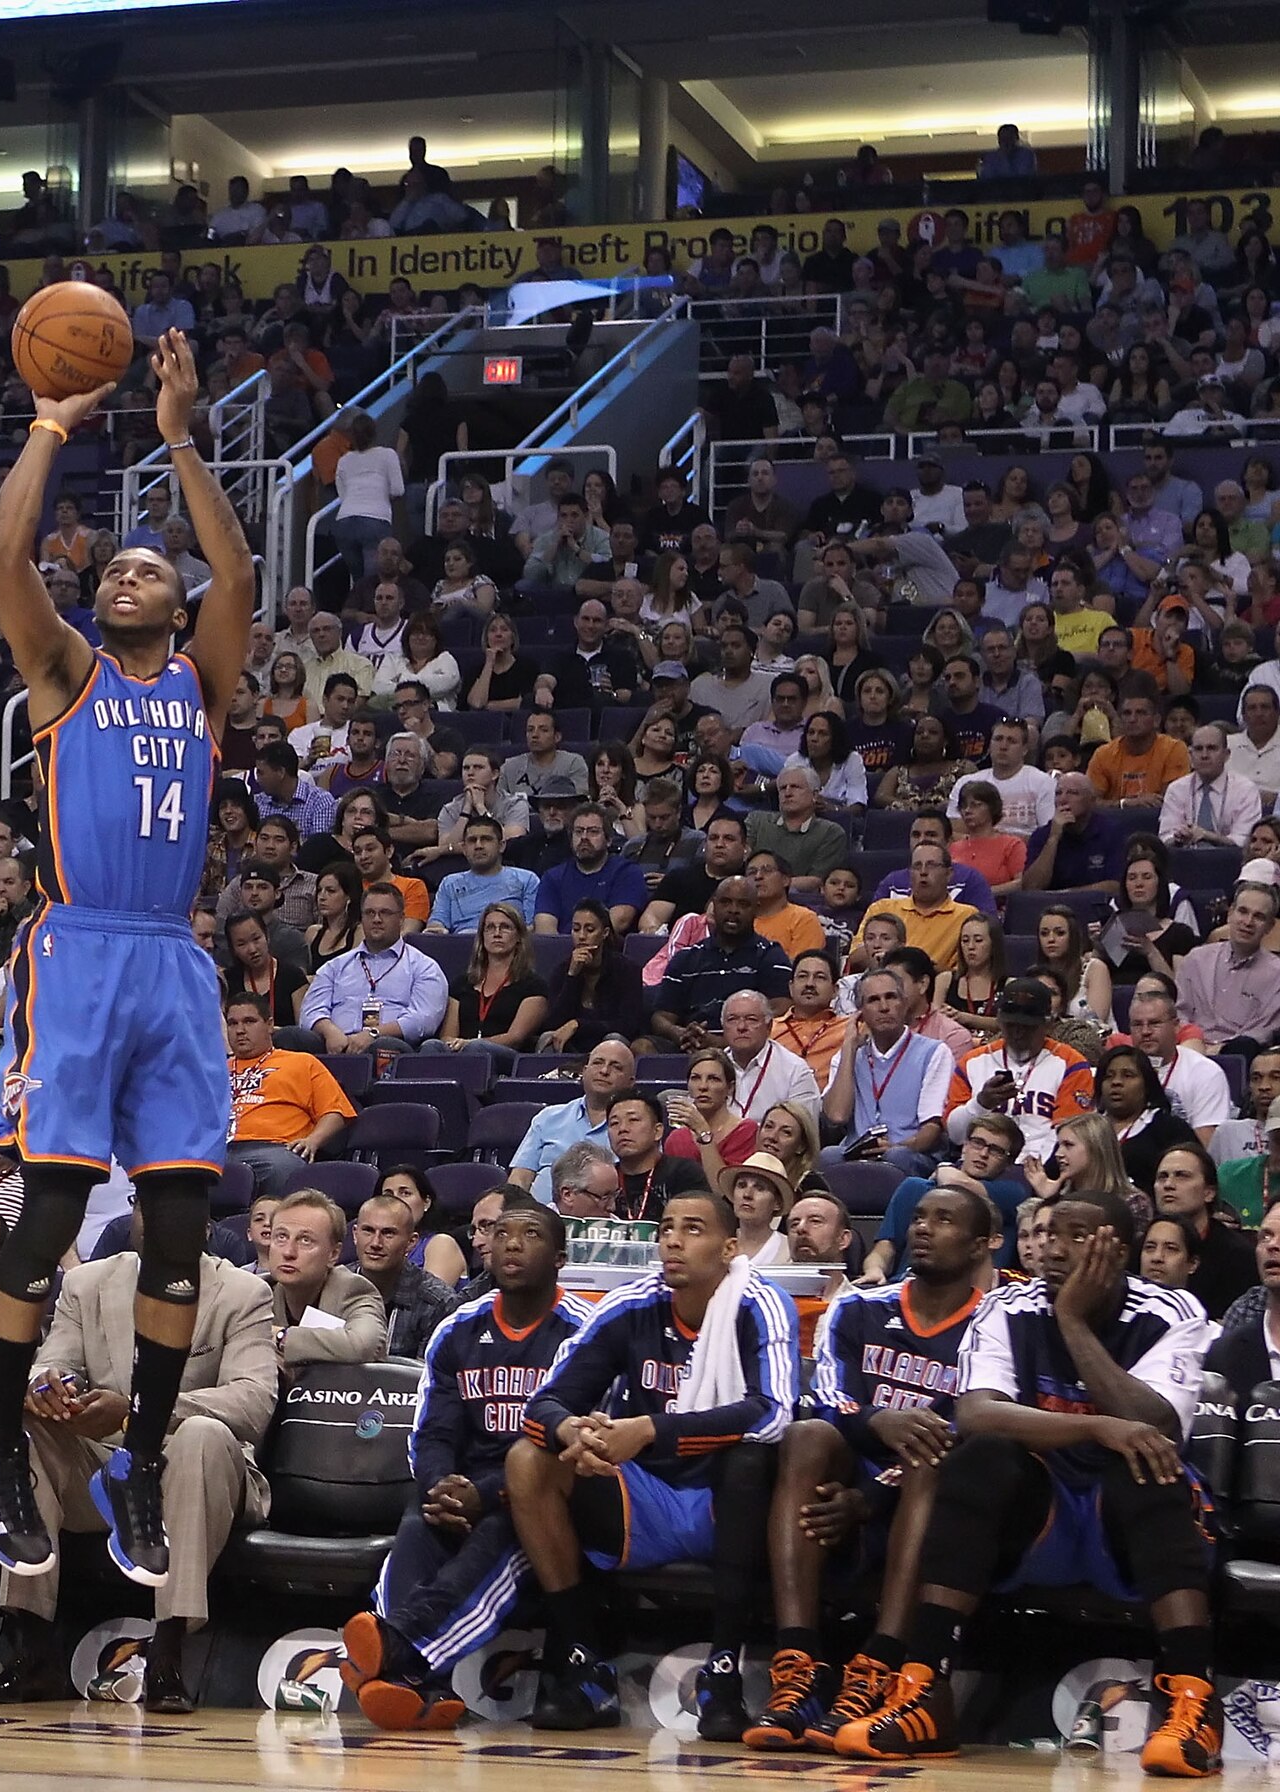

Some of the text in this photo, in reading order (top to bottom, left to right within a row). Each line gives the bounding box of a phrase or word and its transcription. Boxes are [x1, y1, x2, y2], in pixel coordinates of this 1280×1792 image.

[348, 247, 378, 278] In
[390, 239, 523, 276] Identity
[131, 734, 187, 771] CITY
[132, 774, 186, 843] 14
[286, 1385, 363, 1406] CASINO
[484, 1402, 522, 1432] CIT
